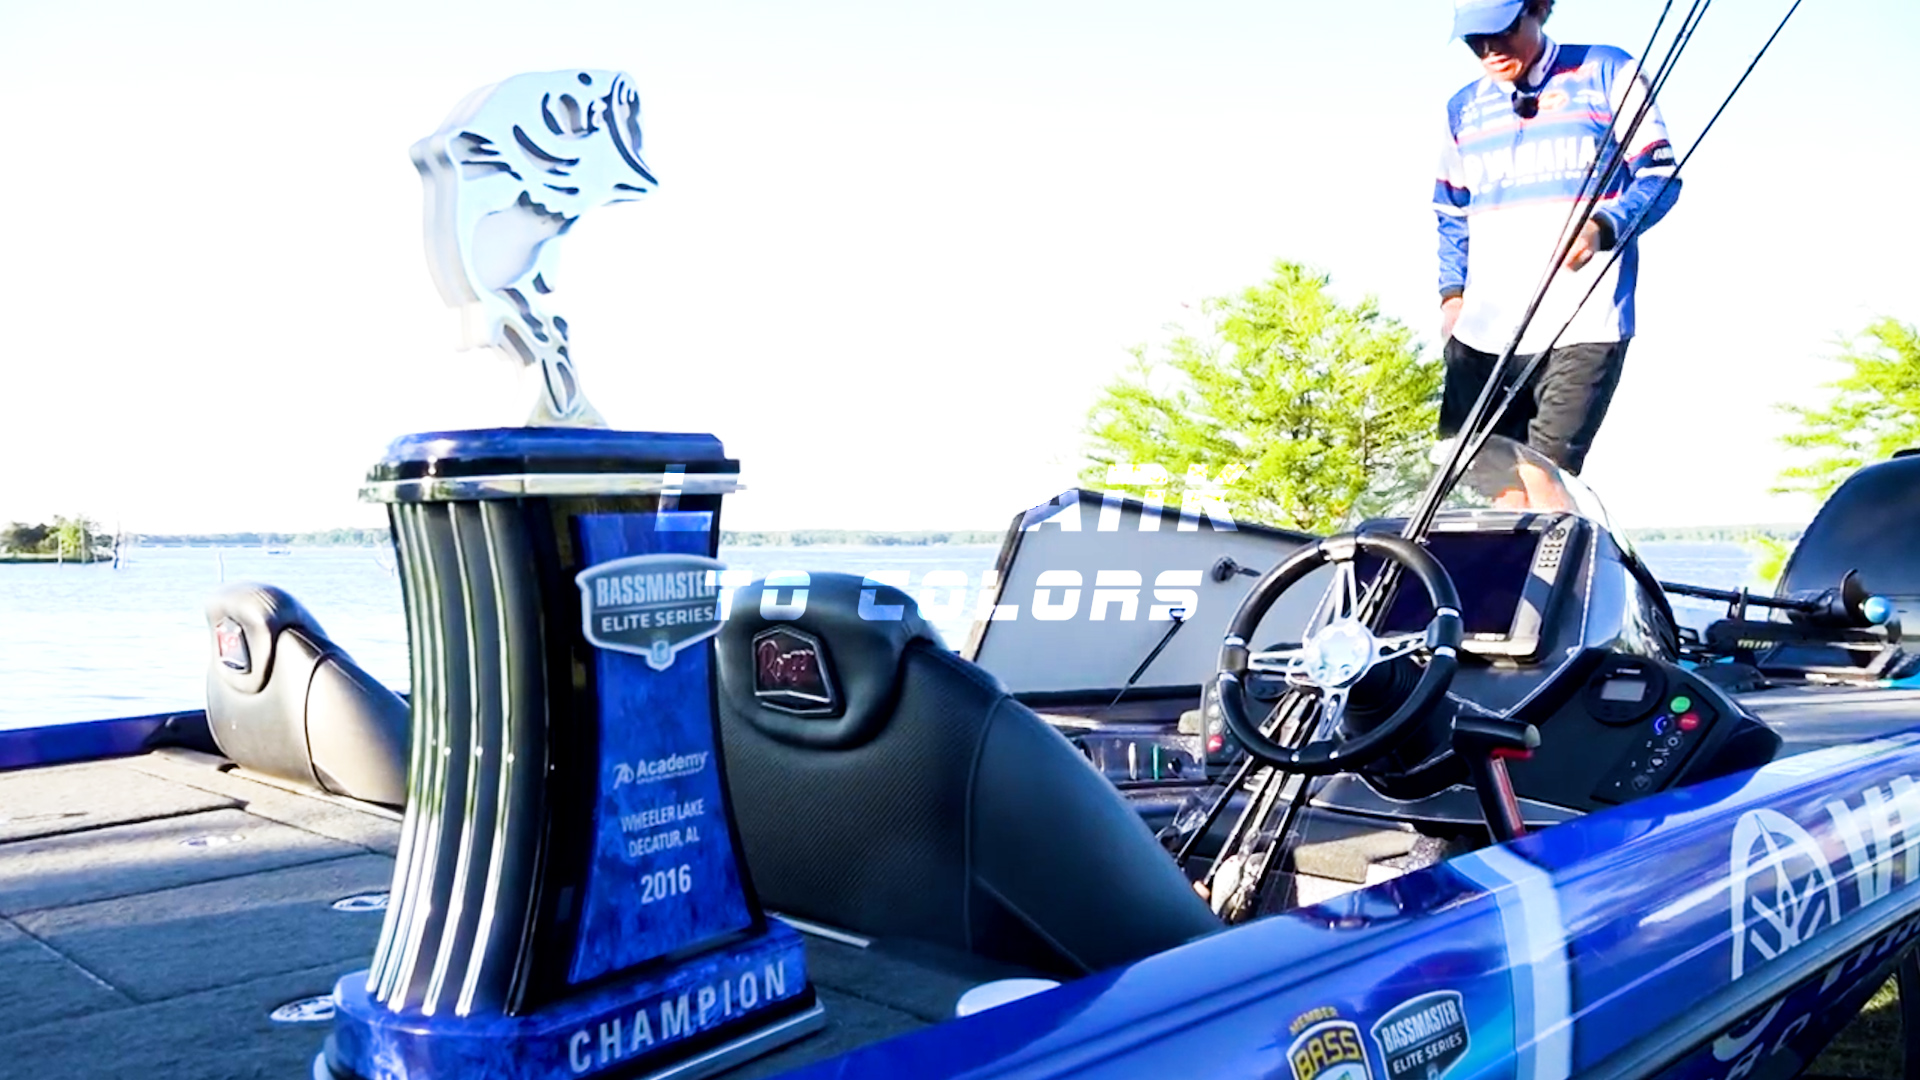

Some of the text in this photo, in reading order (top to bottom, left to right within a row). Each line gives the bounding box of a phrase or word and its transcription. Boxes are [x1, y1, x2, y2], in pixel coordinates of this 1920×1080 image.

[601, 605, 714, 632] ELITE SERIES
[636, 751, 709, 777] Academy
[621, 798, 705, 833] WHEELER LAKE
[685, 826, 701, 843] AL
[640, 863, 692, 904] 2016
[568, 960, 786, 1074] CHAMPION
[1289, 1005, 1339, 1036] MEMBER
[1381, 999, 1461, 1054] BASSMASTER
[1294, 1030, 1362, 1080] BASS
[1393, 1031, 1463, 1075] ELITE SERIES
